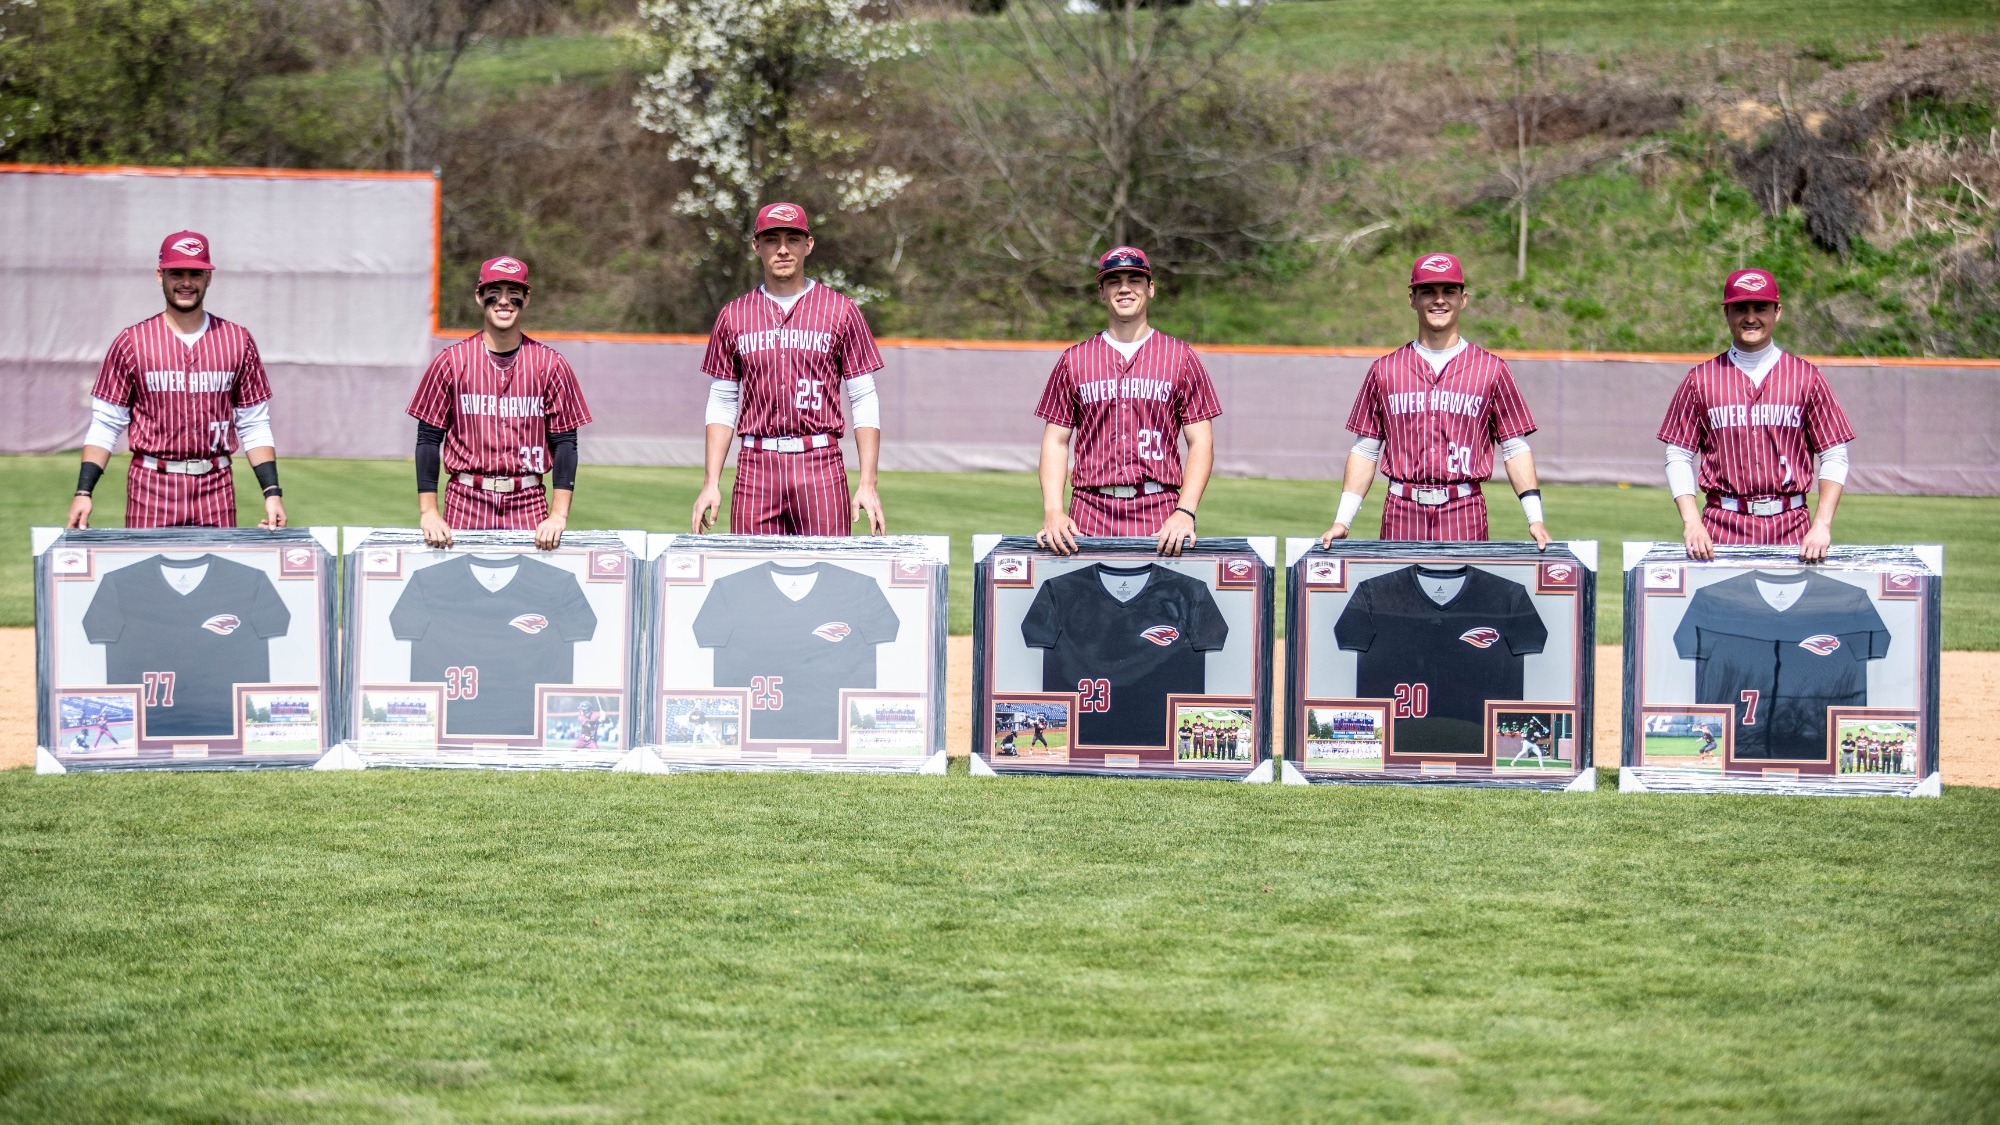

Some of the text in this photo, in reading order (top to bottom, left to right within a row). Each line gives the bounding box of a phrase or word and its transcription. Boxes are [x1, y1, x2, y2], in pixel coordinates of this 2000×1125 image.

[738, 328, 832, 356] RIVER HAWKS
[146, 370, 235, 394] RIVER HAWKS
[795, 378, 824, 411] 25
[1078, 379, 1173, 405] RIVER HAWKS
[461, 394, 545, 418] RIVER HAWKS
[1389, 389, 1483, 417] RIVER HAWKS
[1707, 404, 1802, 430] RIVER HAWKS
[209, 421, 231, 452] 77
[1137, 429, 1165, 462] 23
[519, 445, 544, 474] 33
[1447, 441, 1472, 475] 20
[143, 671, 176, 707] 77
[444, 666, 479, 701] 33
[750, 675, 784, 711] 25
[1078, 678, 1111, 713] 23
[1394, 683, 1429, 718] 20
[1740, 689, 1760, 726] 7
